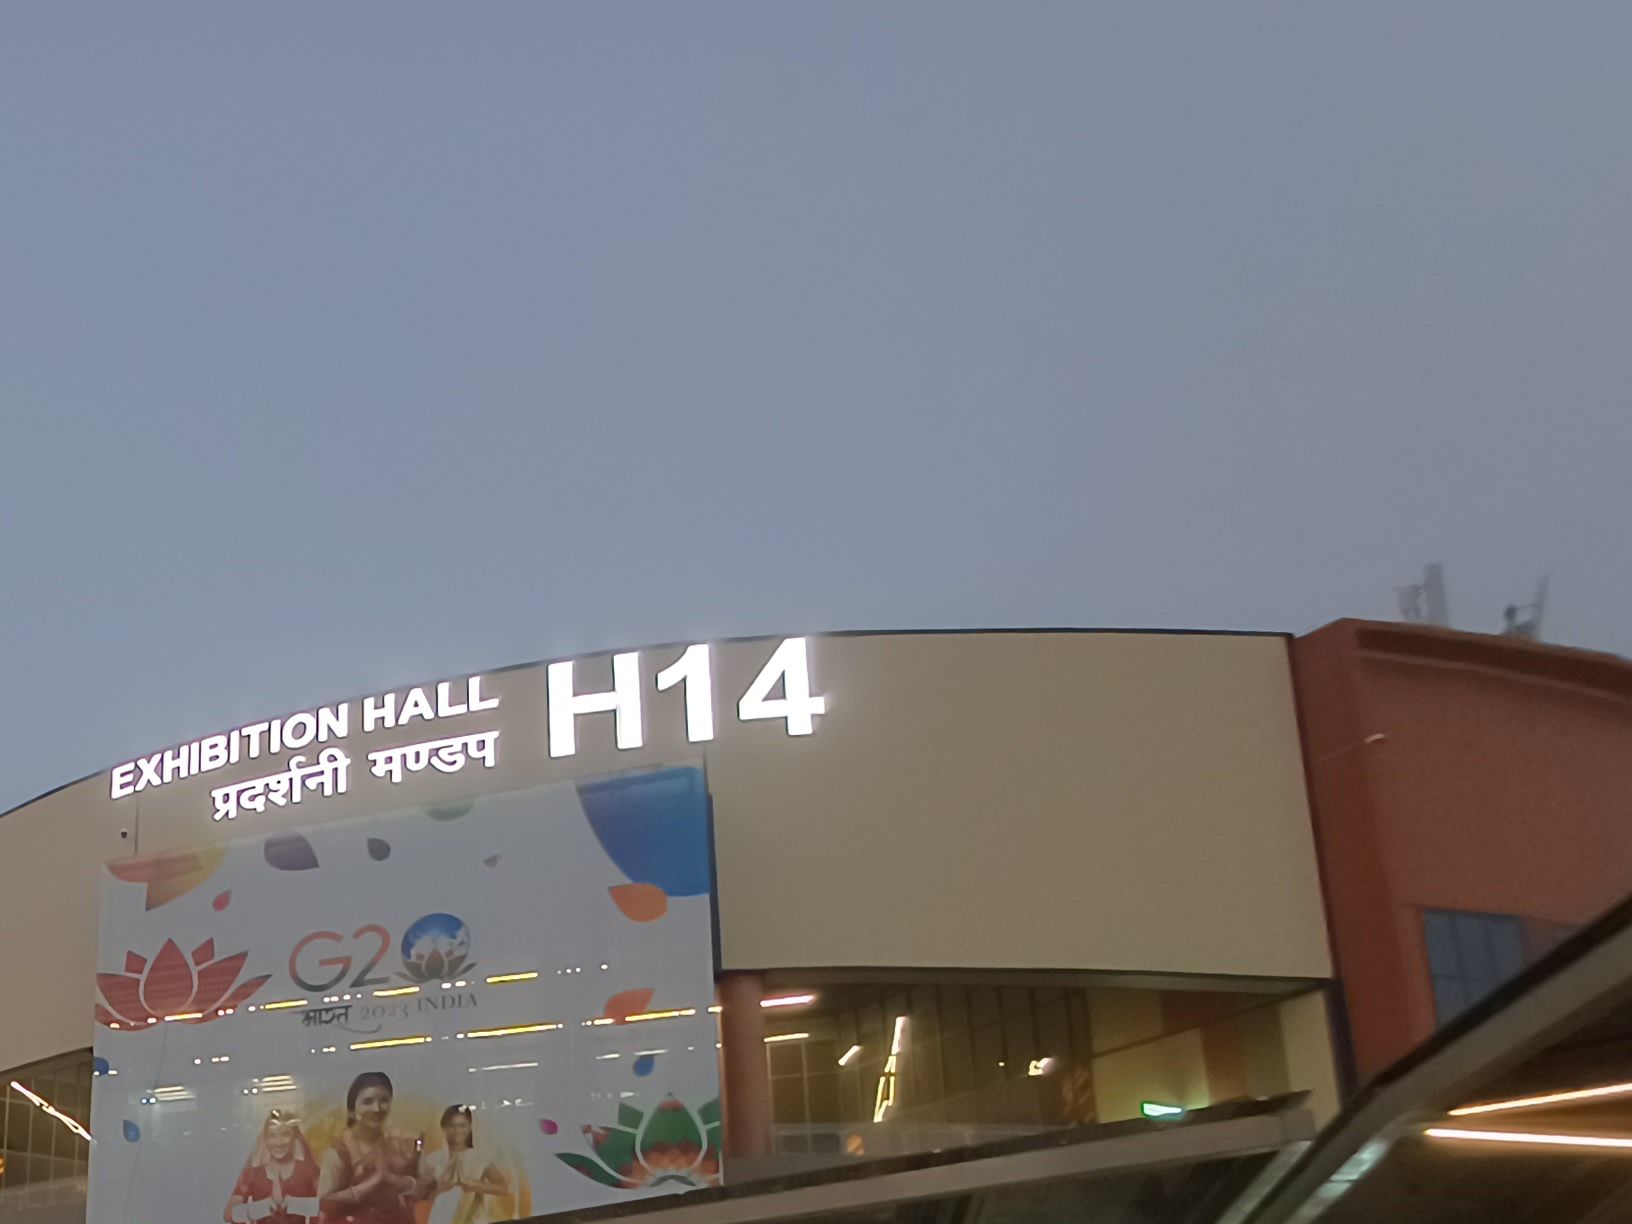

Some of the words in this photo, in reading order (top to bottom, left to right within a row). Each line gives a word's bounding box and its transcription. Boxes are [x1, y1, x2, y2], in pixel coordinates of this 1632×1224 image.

[109, 702, 349, 800] EXHIBITION
[362, 675, 499, 733] HALL
[547, 636, 825, 758] H14
[210, 746, 350, 821] प्रदर्शनी
[368, 730, 500, 783] मण्डप
[360, 1002, 409, 1022] 2023
[417, 992, 478, 1012] INDIA
